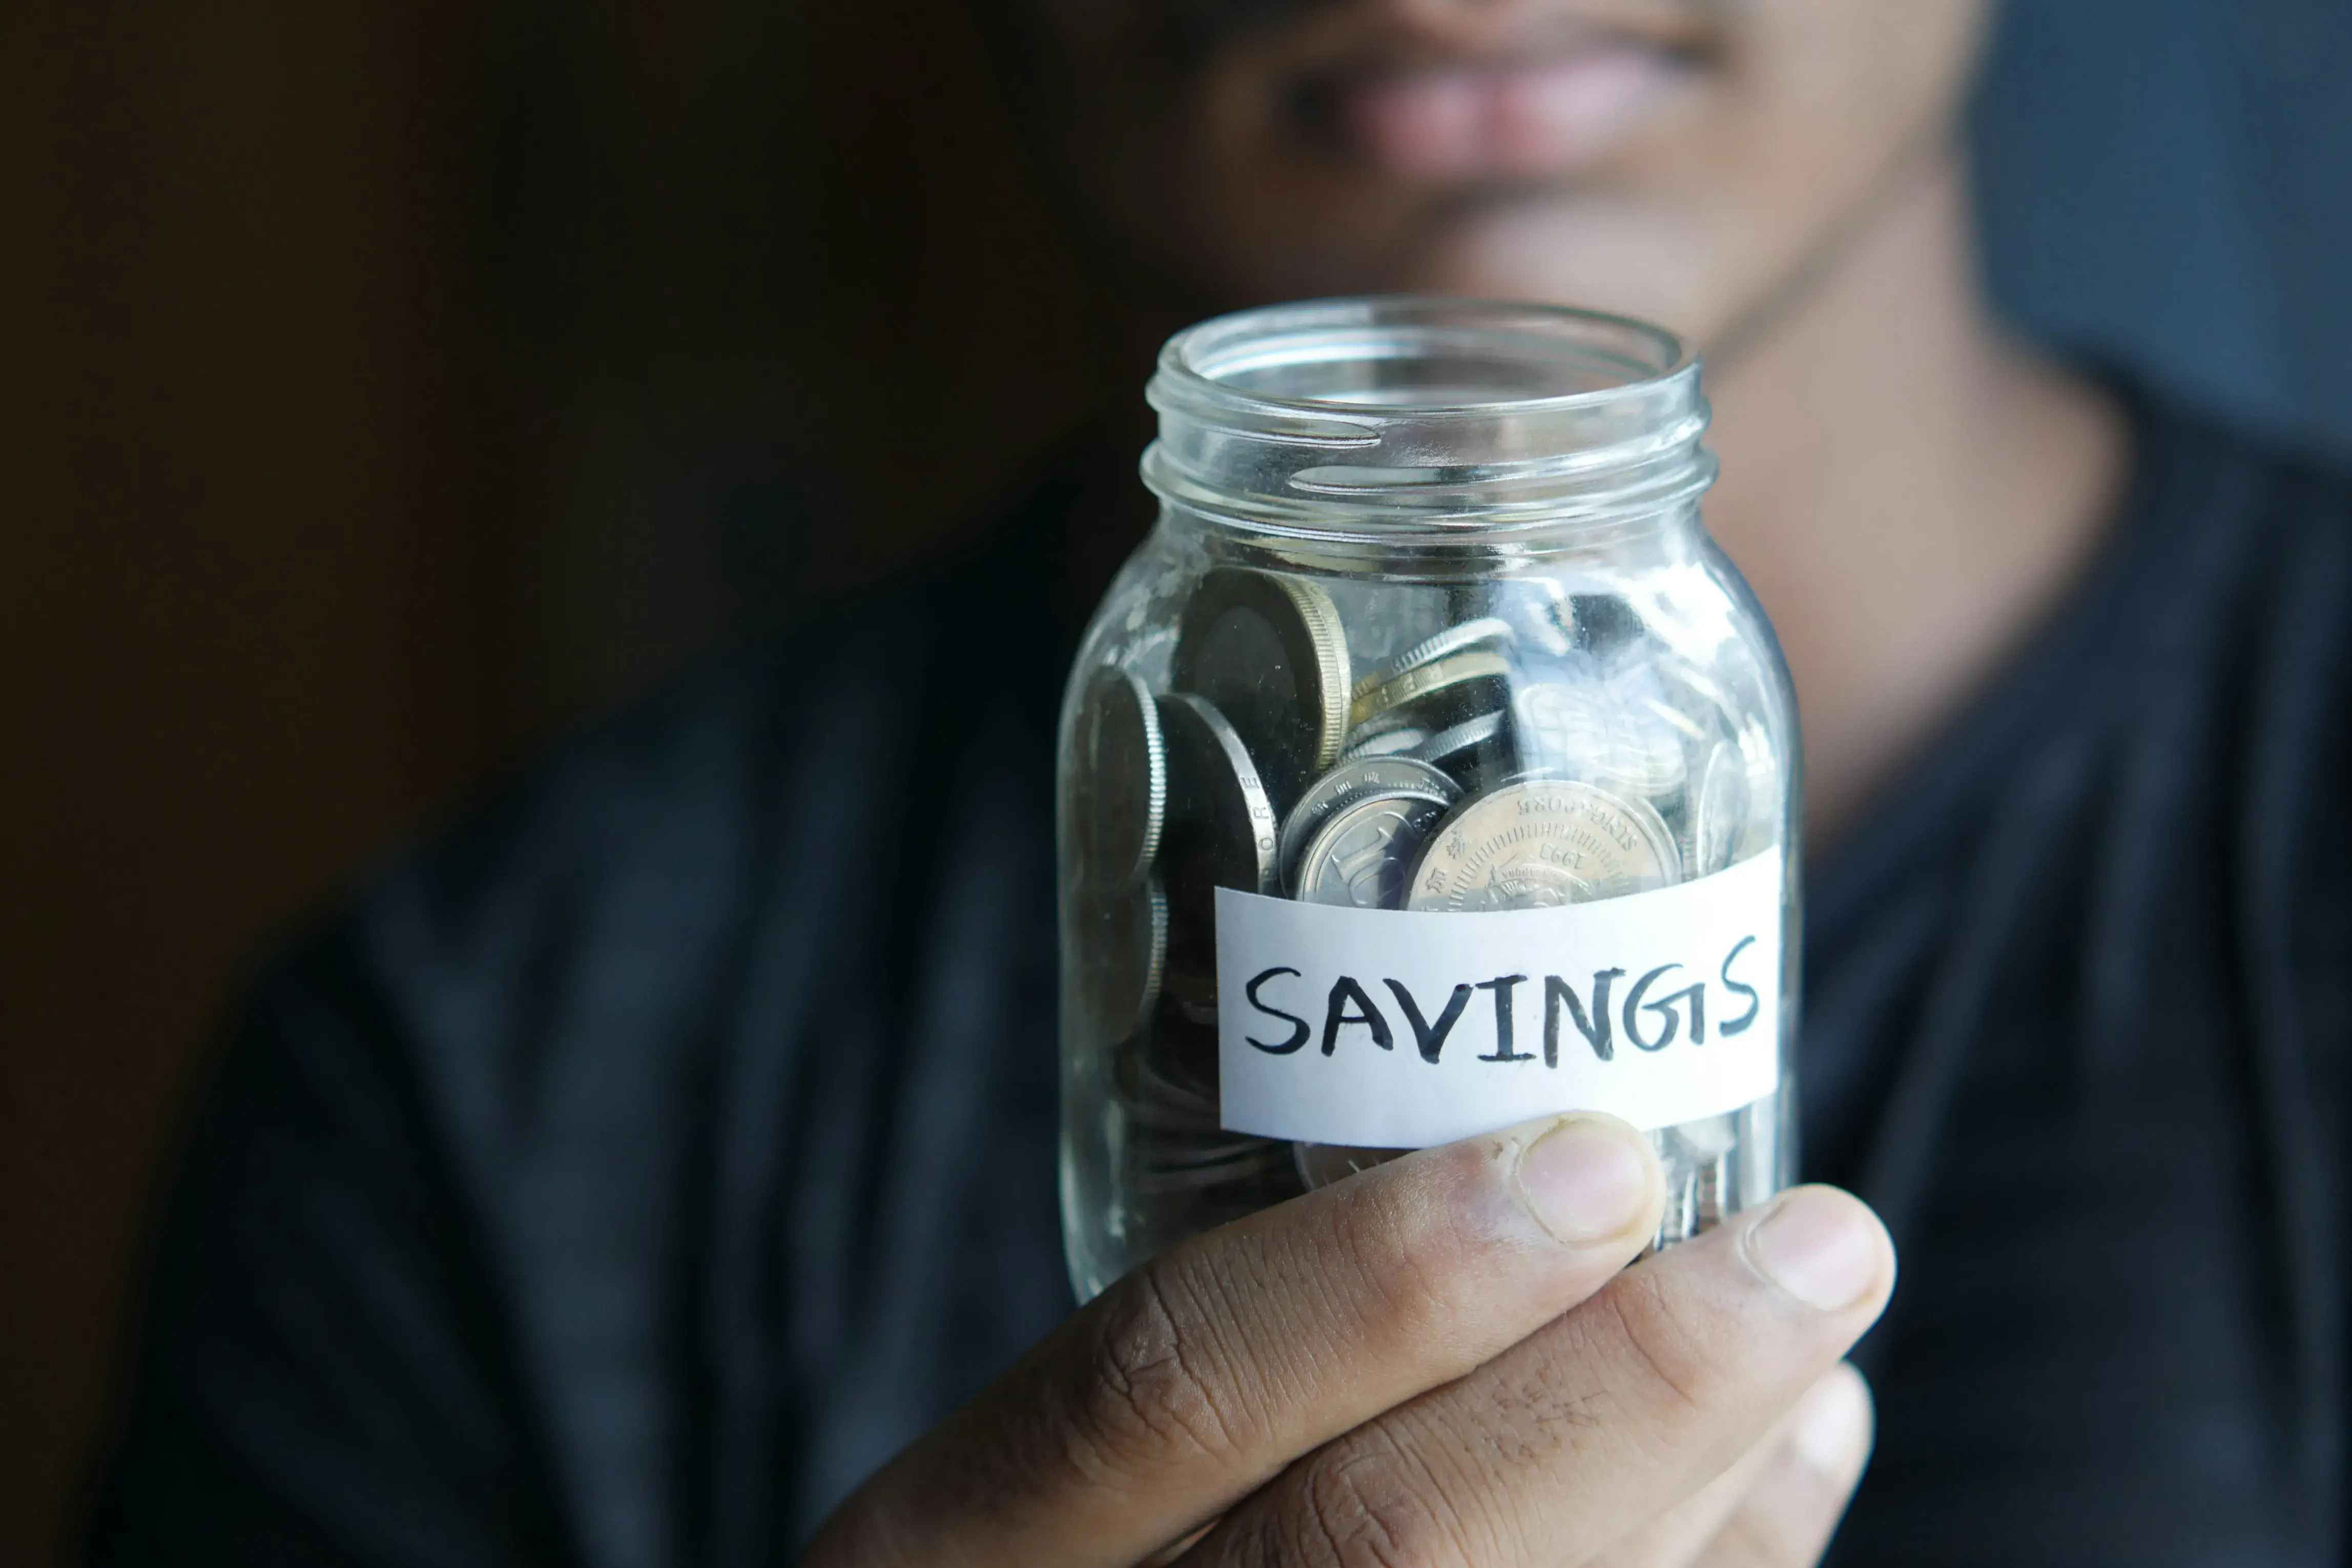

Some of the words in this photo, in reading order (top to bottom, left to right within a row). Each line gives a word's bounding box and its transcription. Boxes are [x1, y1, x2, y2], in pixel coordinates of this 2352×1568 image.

[1516, 794, 1640, 852] SINGAPORE
[1539, 842, 1587, 870] 1993
[1245, 935, 1759, 1069] SAVINGS
